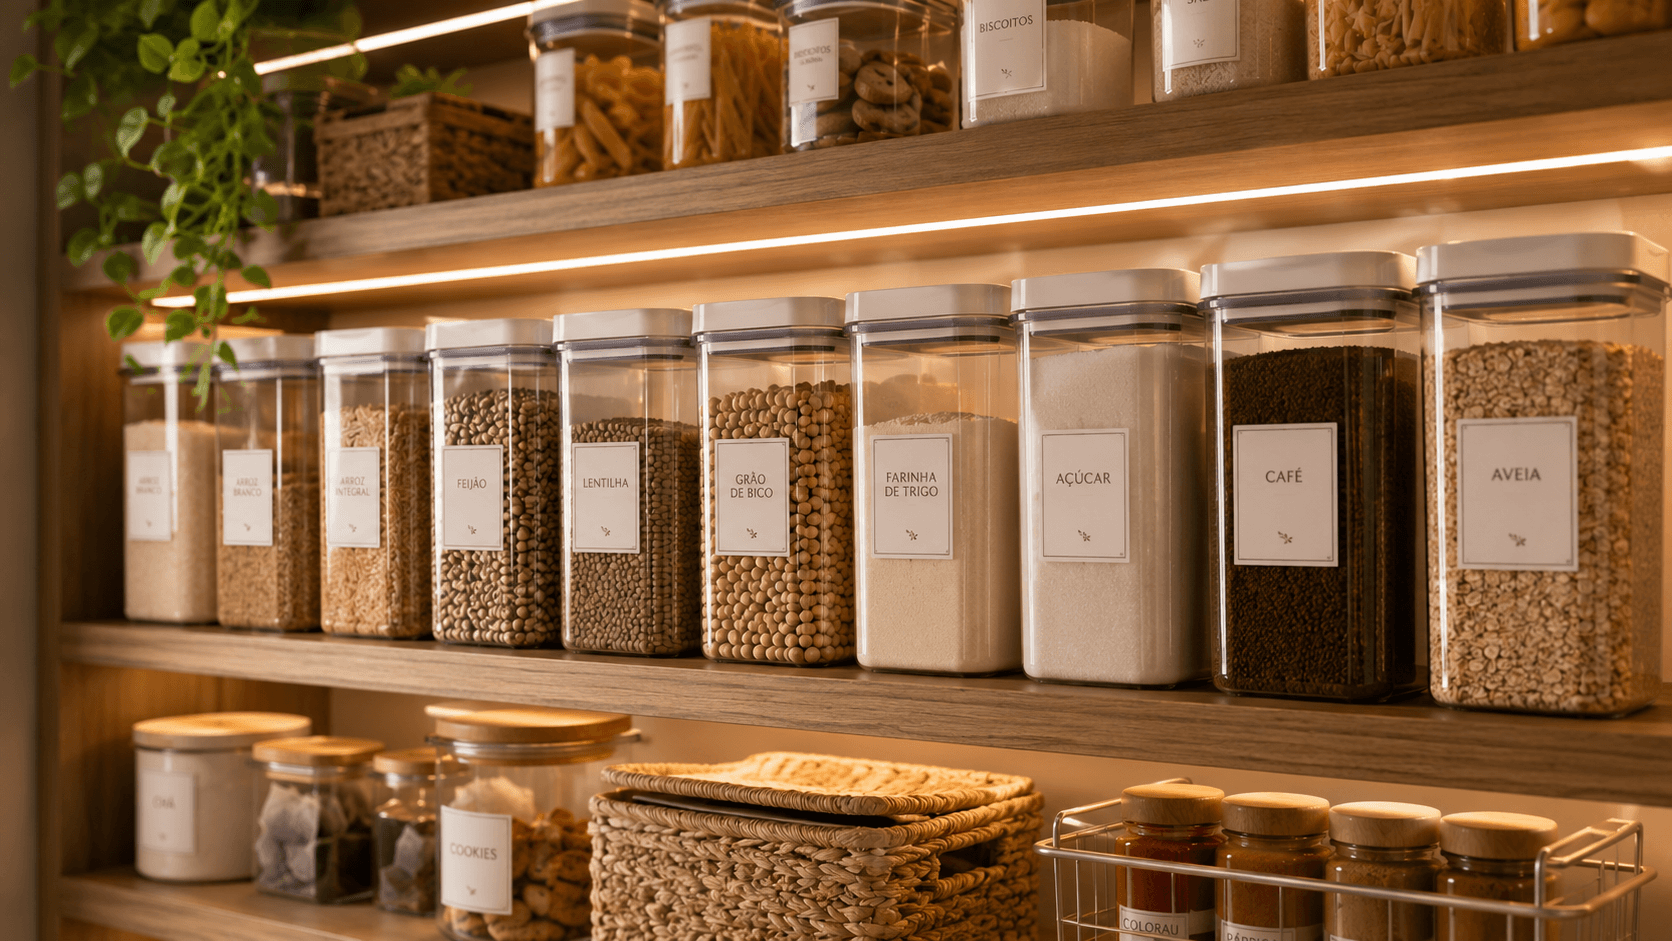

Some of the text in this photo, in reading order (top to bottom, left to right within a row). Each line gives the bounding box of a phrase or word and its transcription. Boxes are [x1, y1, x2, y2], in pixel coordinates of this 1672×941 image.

[979, 15, 1033, 33] BISCOITOS
[340, 476, 365, 485] ARROZ
[735, 472, 766, 485] GRÃO
[886, 472, 937, 483] FARINHA
[1056, 469, 1111, 487] AÇÚCAR
[1265, 467, 1303, 483] CAFÉ
[1491, 467, 1541, 481] AVEIA
[457, 477, 487, 491] FEIJÃO
[583, 477, 629, 489] LENTILHA
[233, 488, 262, 496] BRANCO
[335, 487, 370, 496] INTEGRAL
[730, 487, 774, 499] DE BICO
[884, 485, 939, 497] DE TRIGO
[450, 842, 498, 861] COOKIES
[1123, 917, 1179, 936] COLORAU
